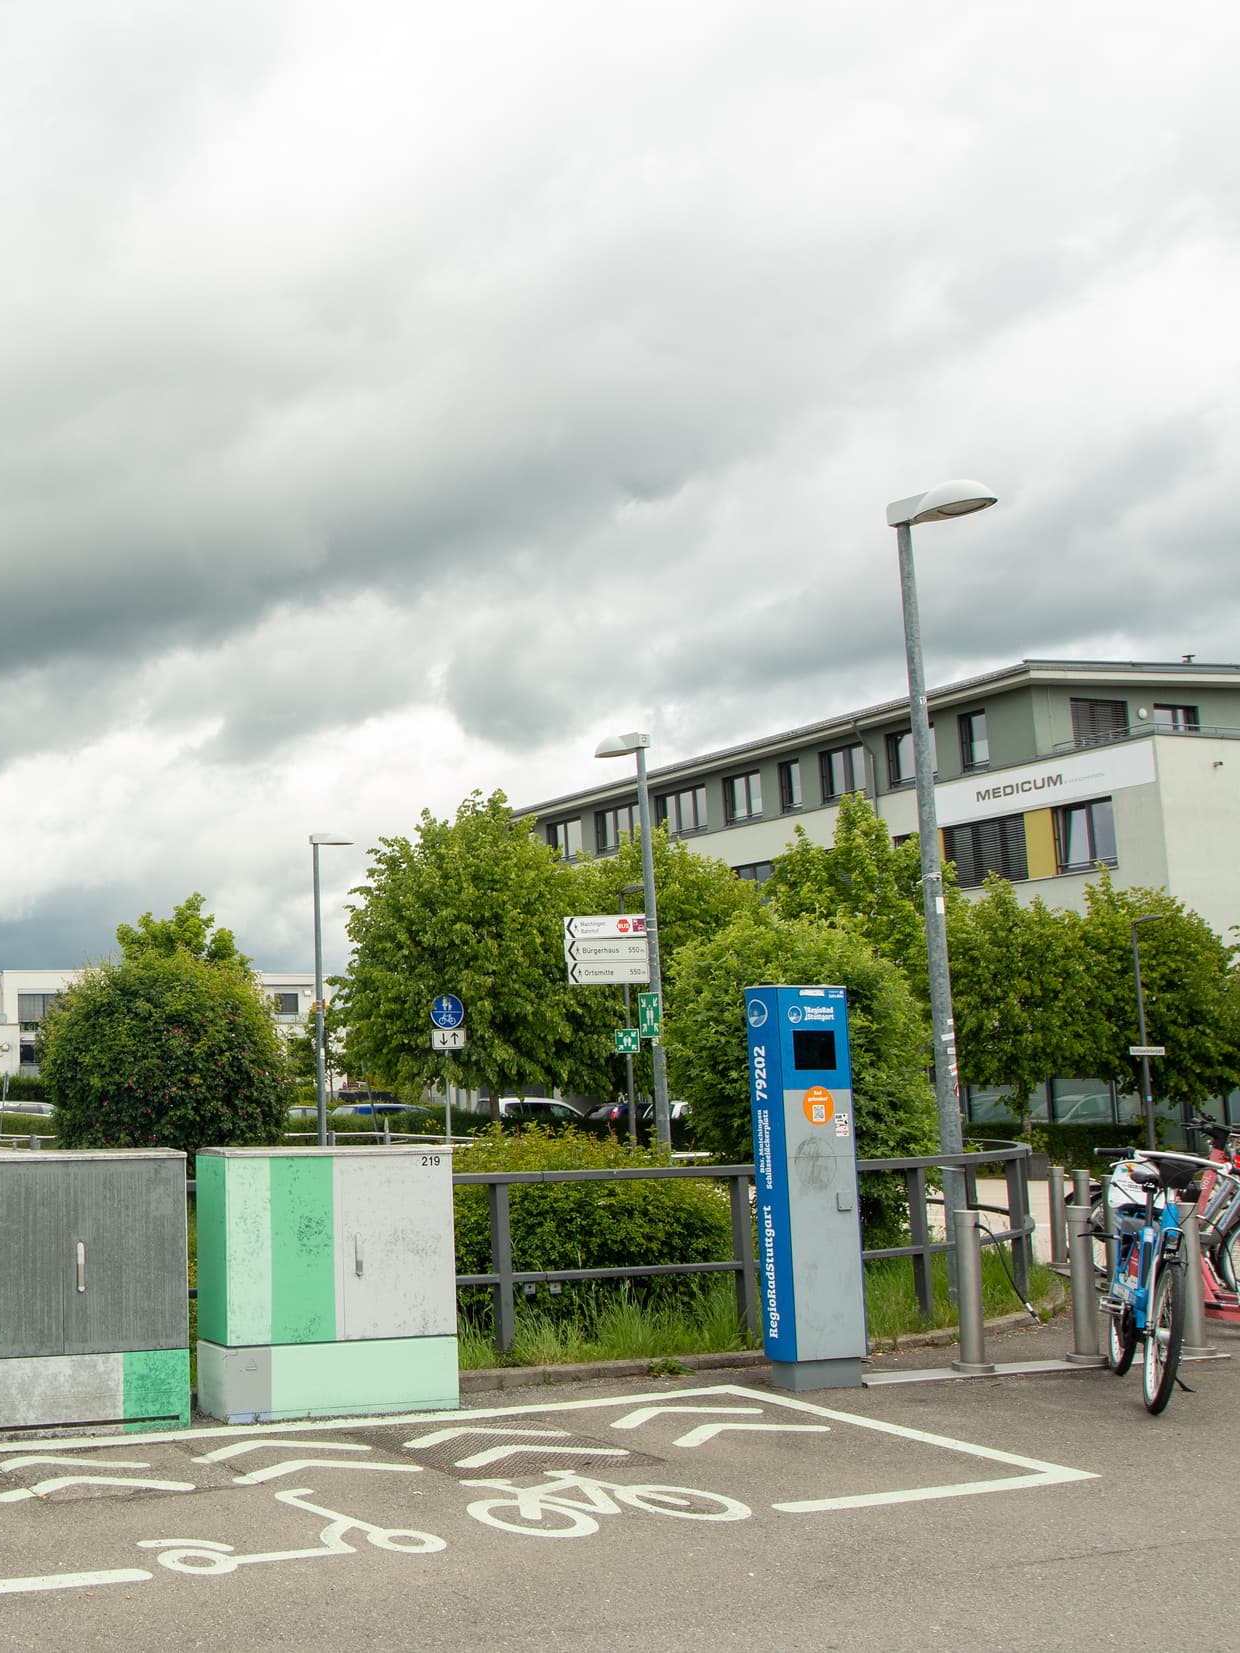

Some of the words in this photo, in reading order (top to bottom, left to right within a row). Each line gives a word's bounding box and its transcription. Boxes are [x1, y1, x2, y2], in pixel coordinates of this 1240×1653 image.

[975, 773, 1063, 802] MEDICUM
[582, 946, 619, 956] Bürgerhaus
[628, 946, 640, 954] 550
[584, 969, 614, 977] Ortsmitte
[753, 1045, 769, 1102] 79202
[421, 1155, 441, 1167] 219
[762, 1205, 780, 1339] RegioRadStuttgart
